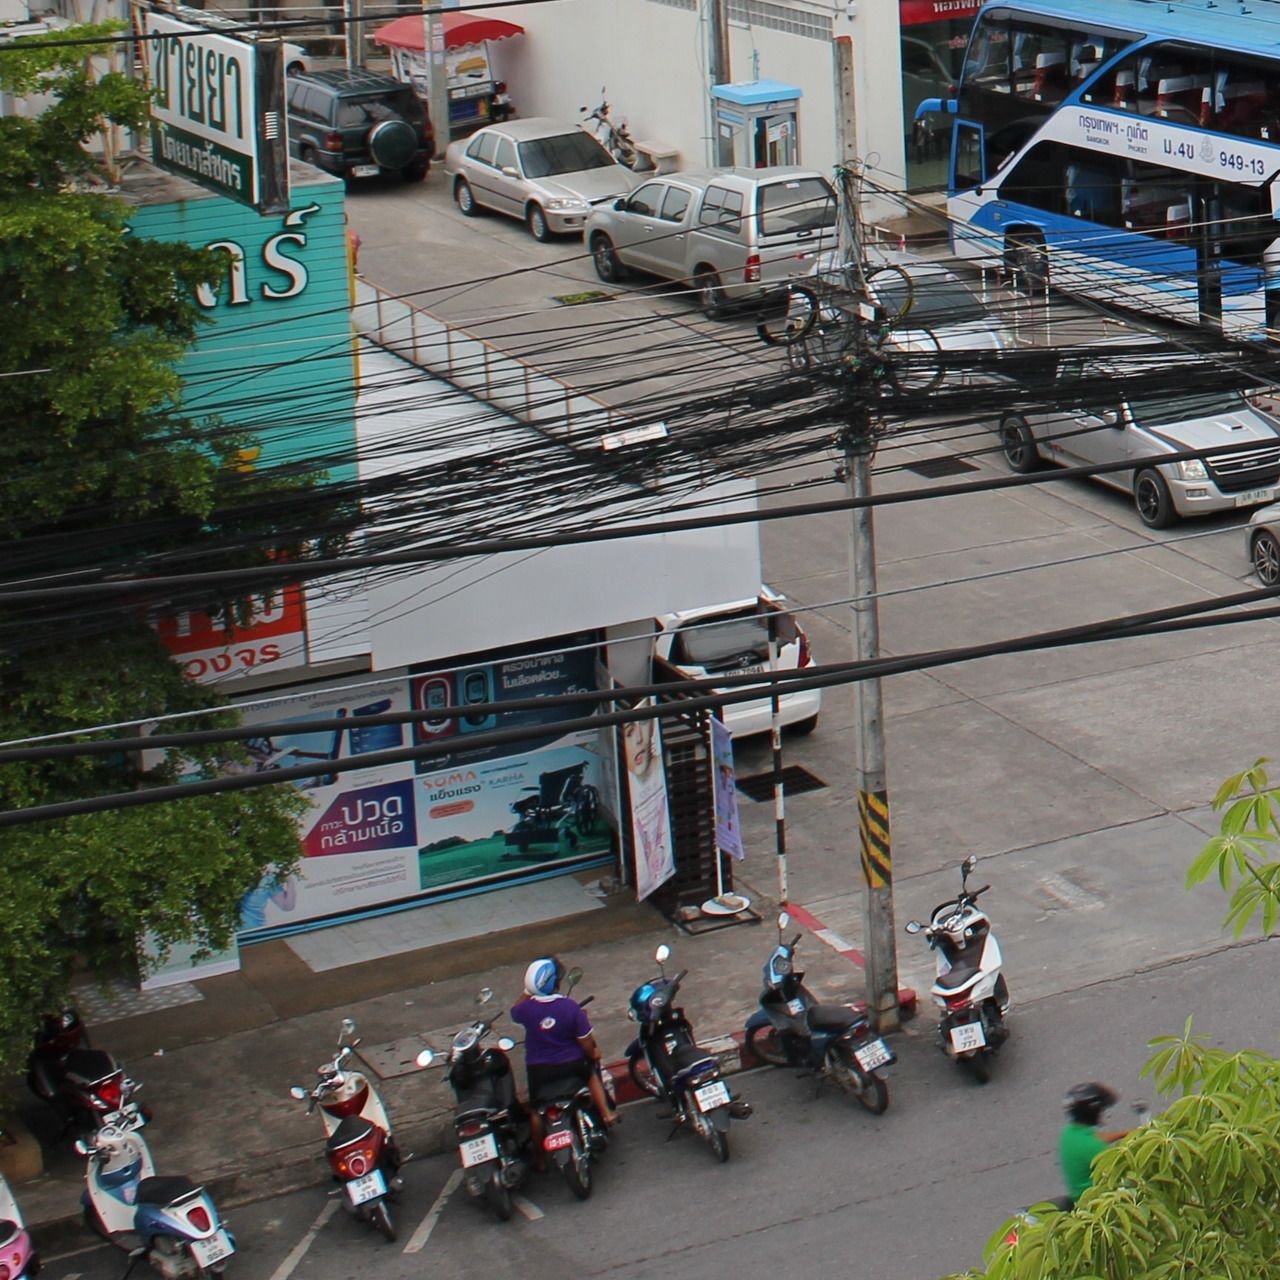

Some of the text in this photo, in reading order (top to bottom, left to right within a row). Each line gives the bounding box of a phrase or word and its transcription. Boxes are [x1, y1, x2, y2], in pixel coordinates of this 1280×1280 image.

[151, 27, 245, 140] ขายยา
[1079, 115, 1119, 133] กรุงเทพฯ
[1127, 122, 1149, 143] ภูเก็ต
[160, 126, 241, 190] โดยเภสัชกร
[1219, 151, 1265, 176] 949-13
[423, 770, 478, 791] SOMA
[430, 782, 481, 802] แข็งแรง
[342, 795, 403, 826] ปวด
[320, 817, 404, 850] กล้ามเนื้อ
